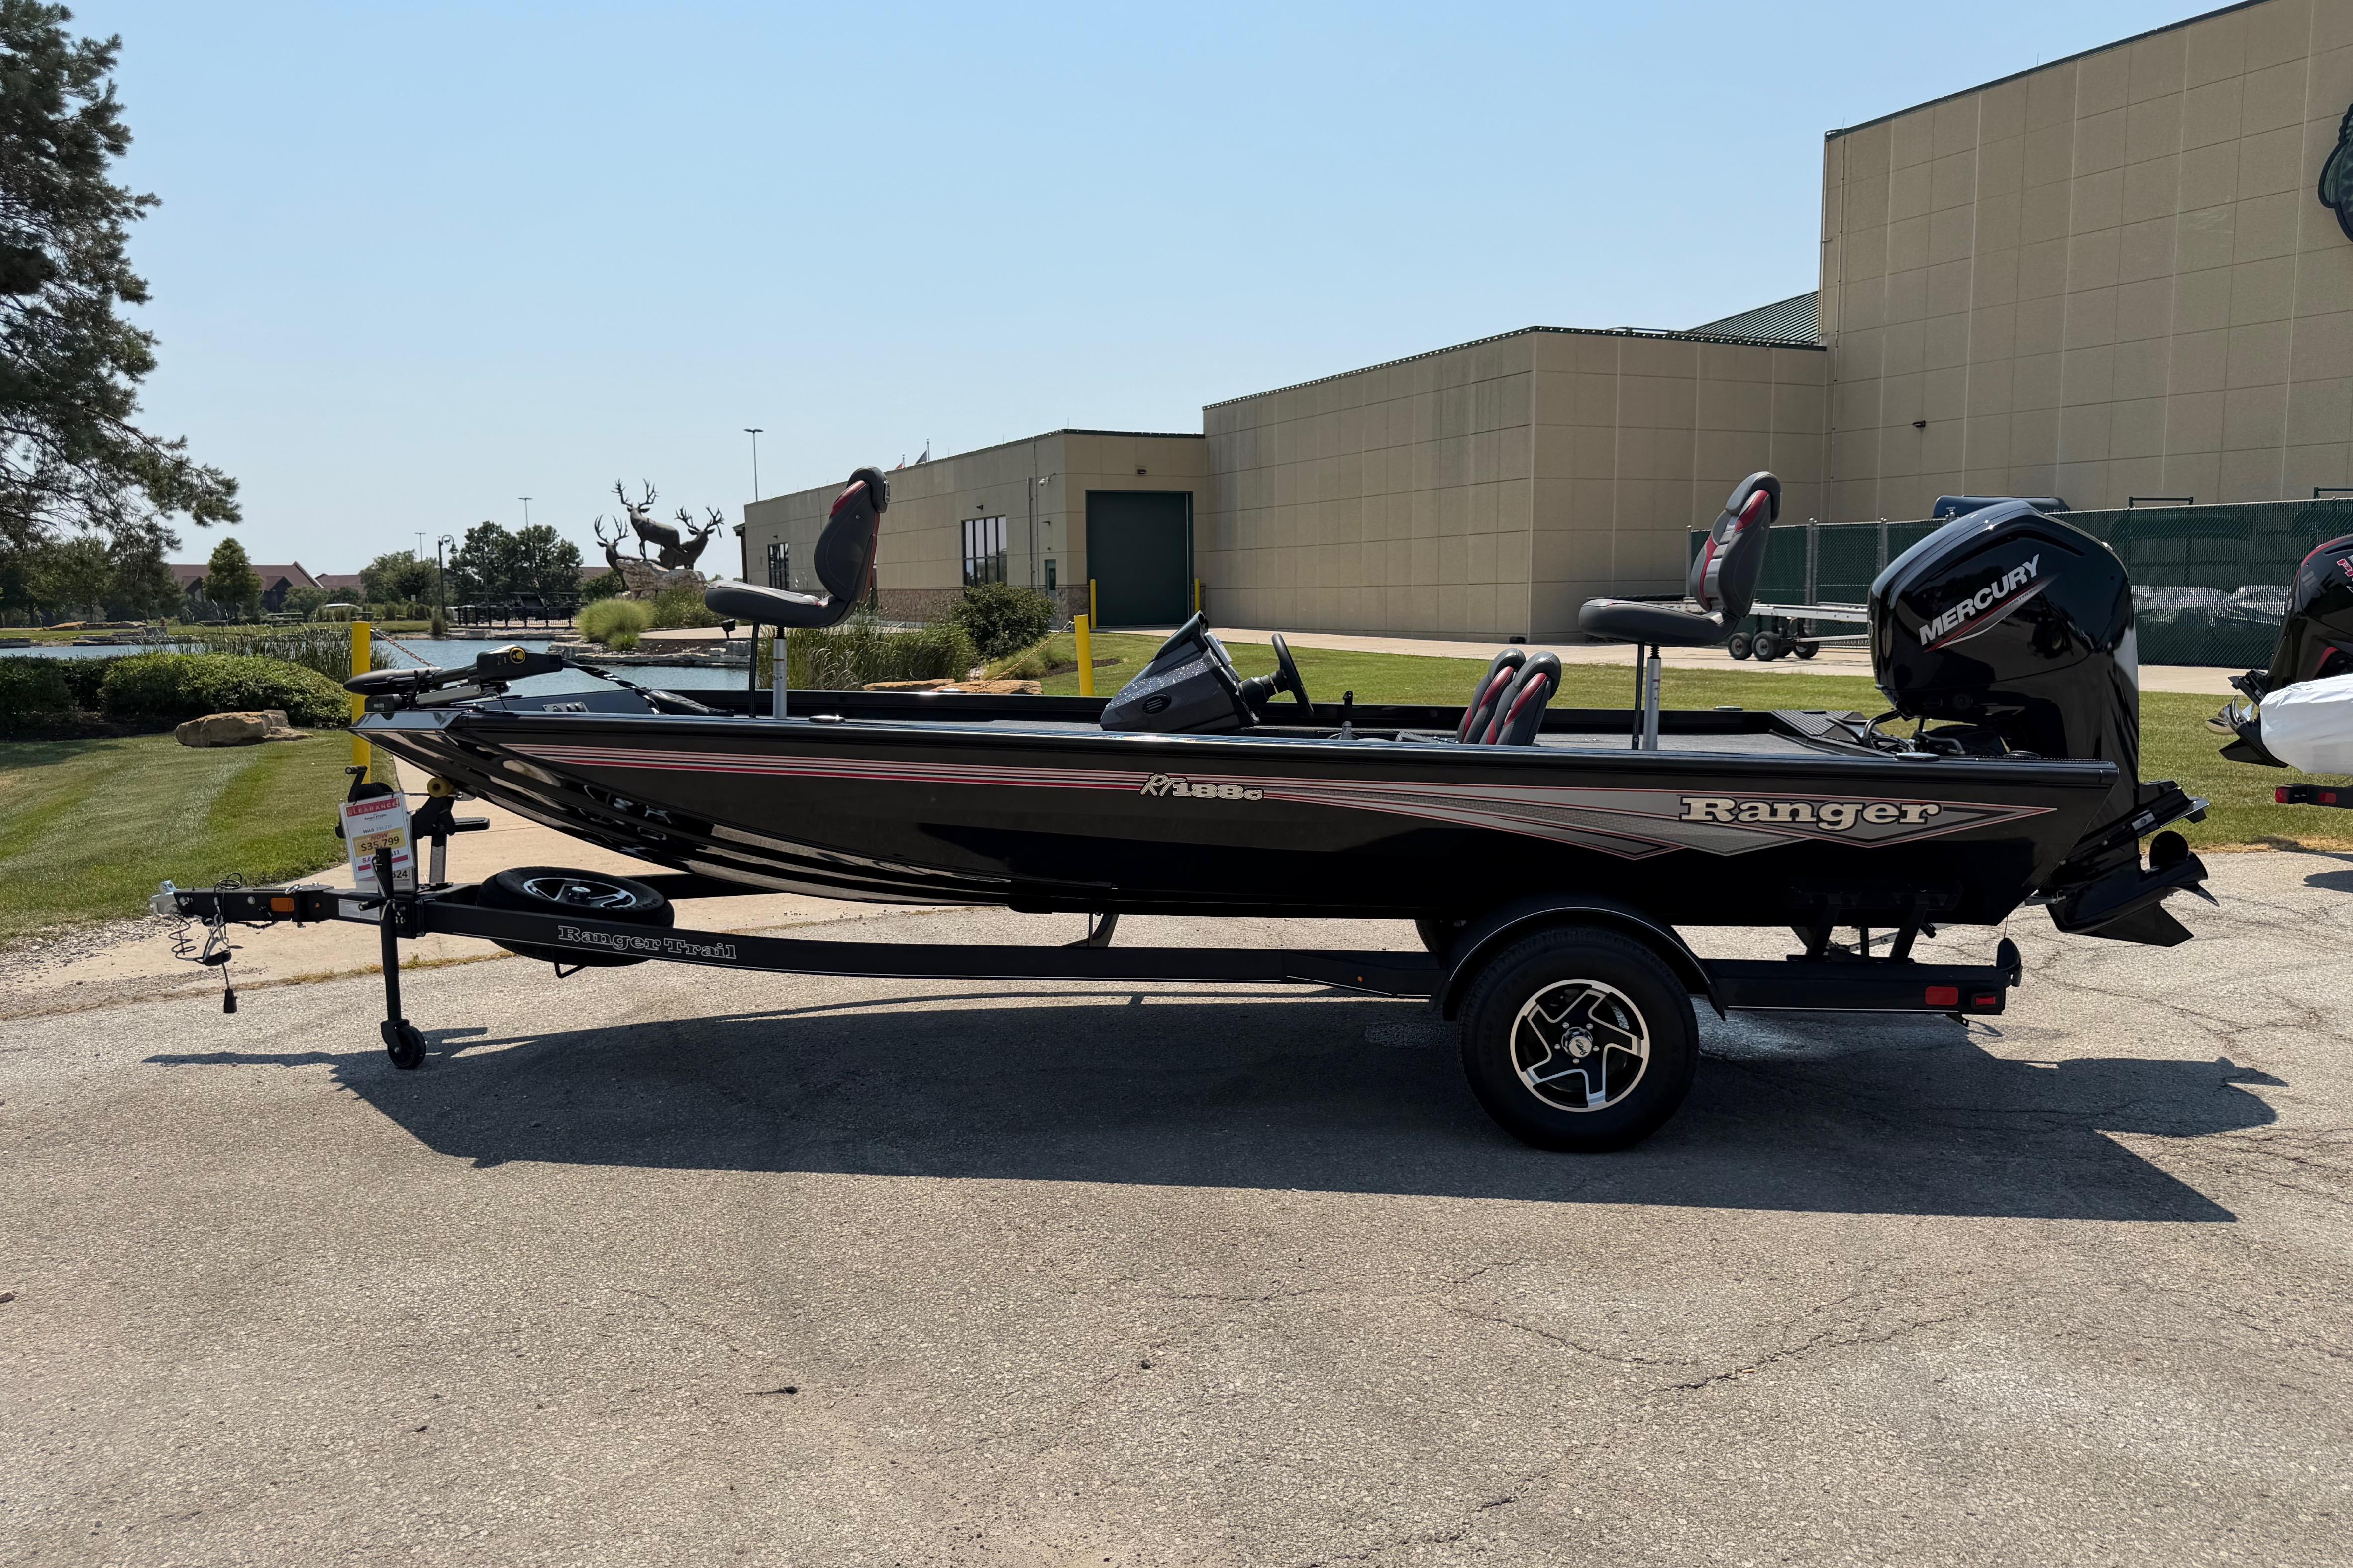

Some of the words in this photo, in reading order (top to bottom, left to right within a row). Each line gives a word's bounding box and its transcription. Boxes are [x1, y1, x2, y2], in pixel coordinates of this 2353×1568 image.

[1919, 554, 2040, 646] MERCURY
[1680, 797, 1940, 831] Ranger
[361, 836, 399, 852] $35,799
[371, 832, 388, 841] NOW
[558, 925, 662, 951] Ranger
[663, 937, 737, 959] Trail
